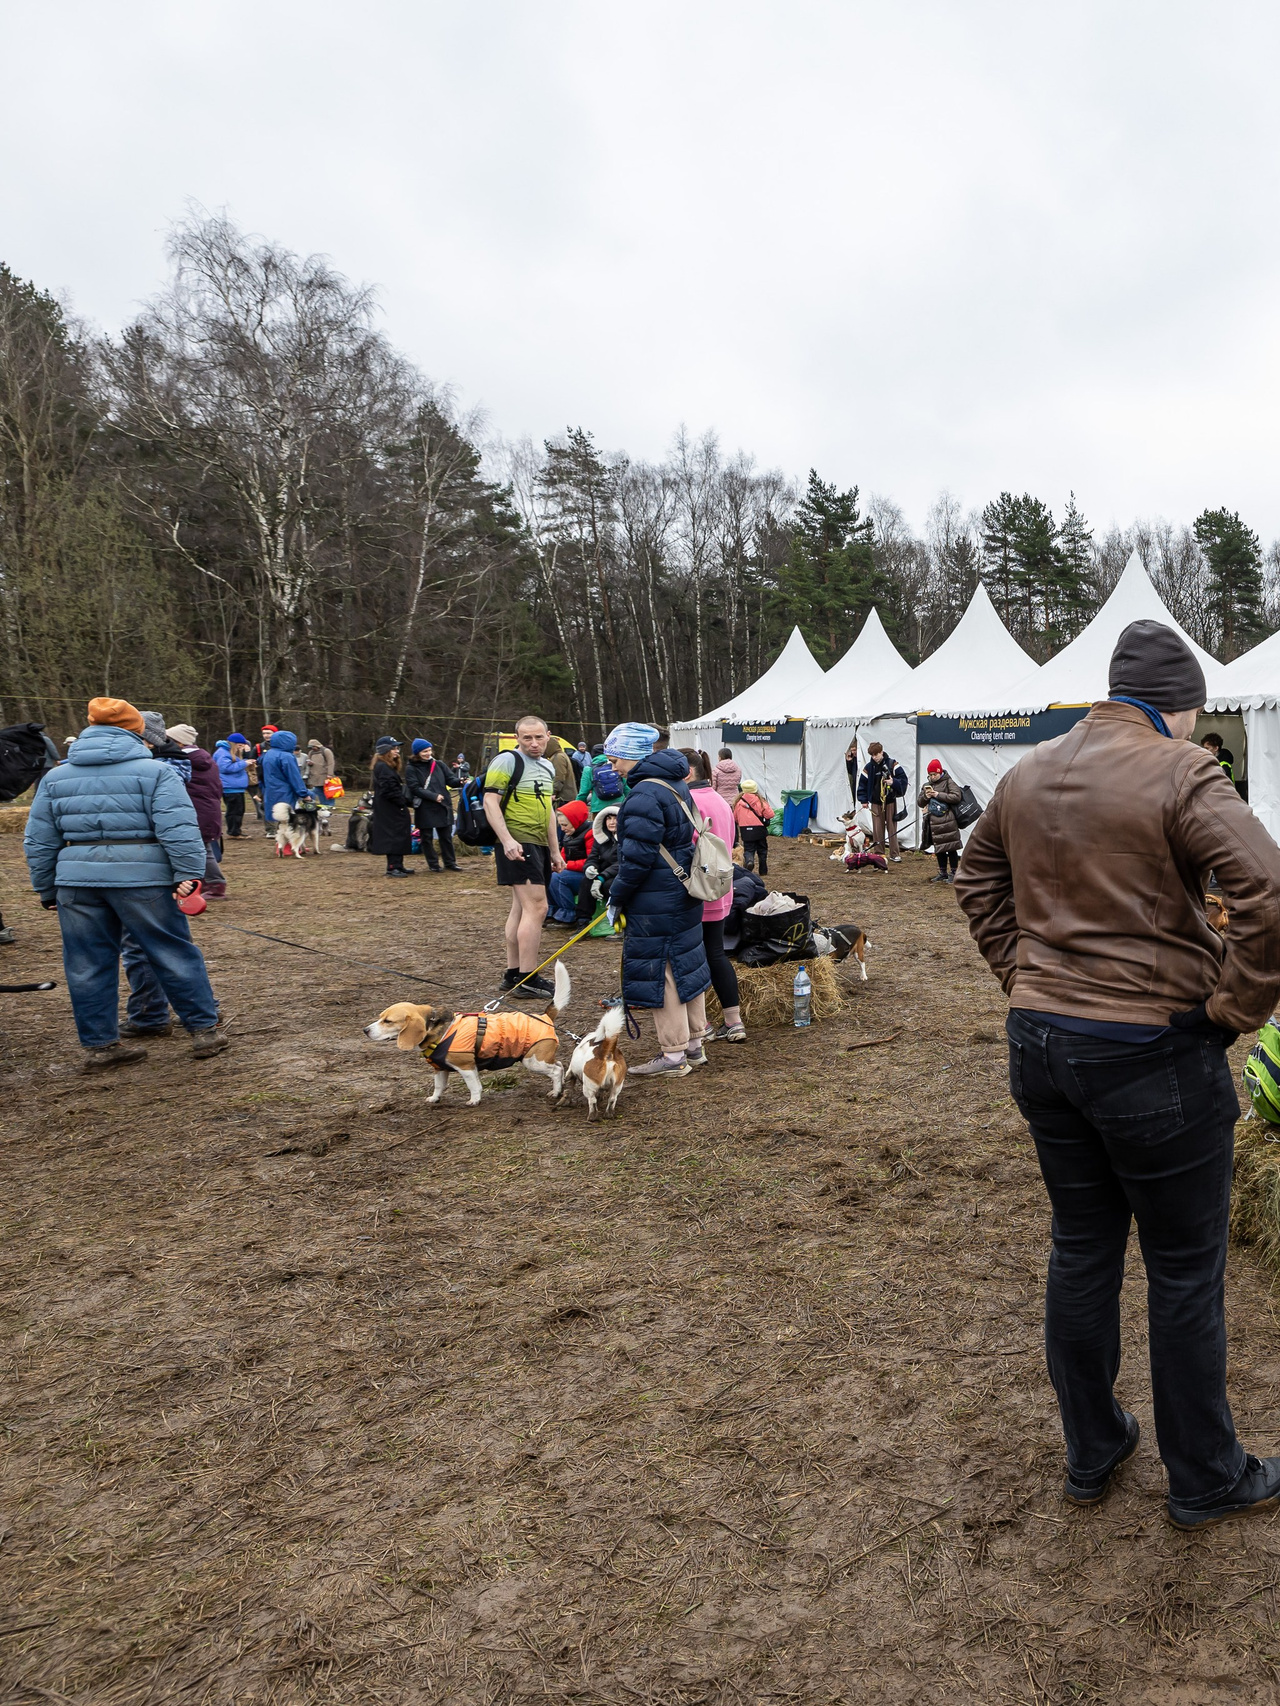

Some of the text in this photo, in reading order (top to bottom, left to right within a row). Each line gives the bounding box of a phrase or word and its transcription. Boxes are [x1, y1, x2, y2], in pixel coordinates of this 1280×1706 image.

[959, 716, 1031, 731] Мужская раздевалка
[970, 731, 1015, 742] Changing tent men
